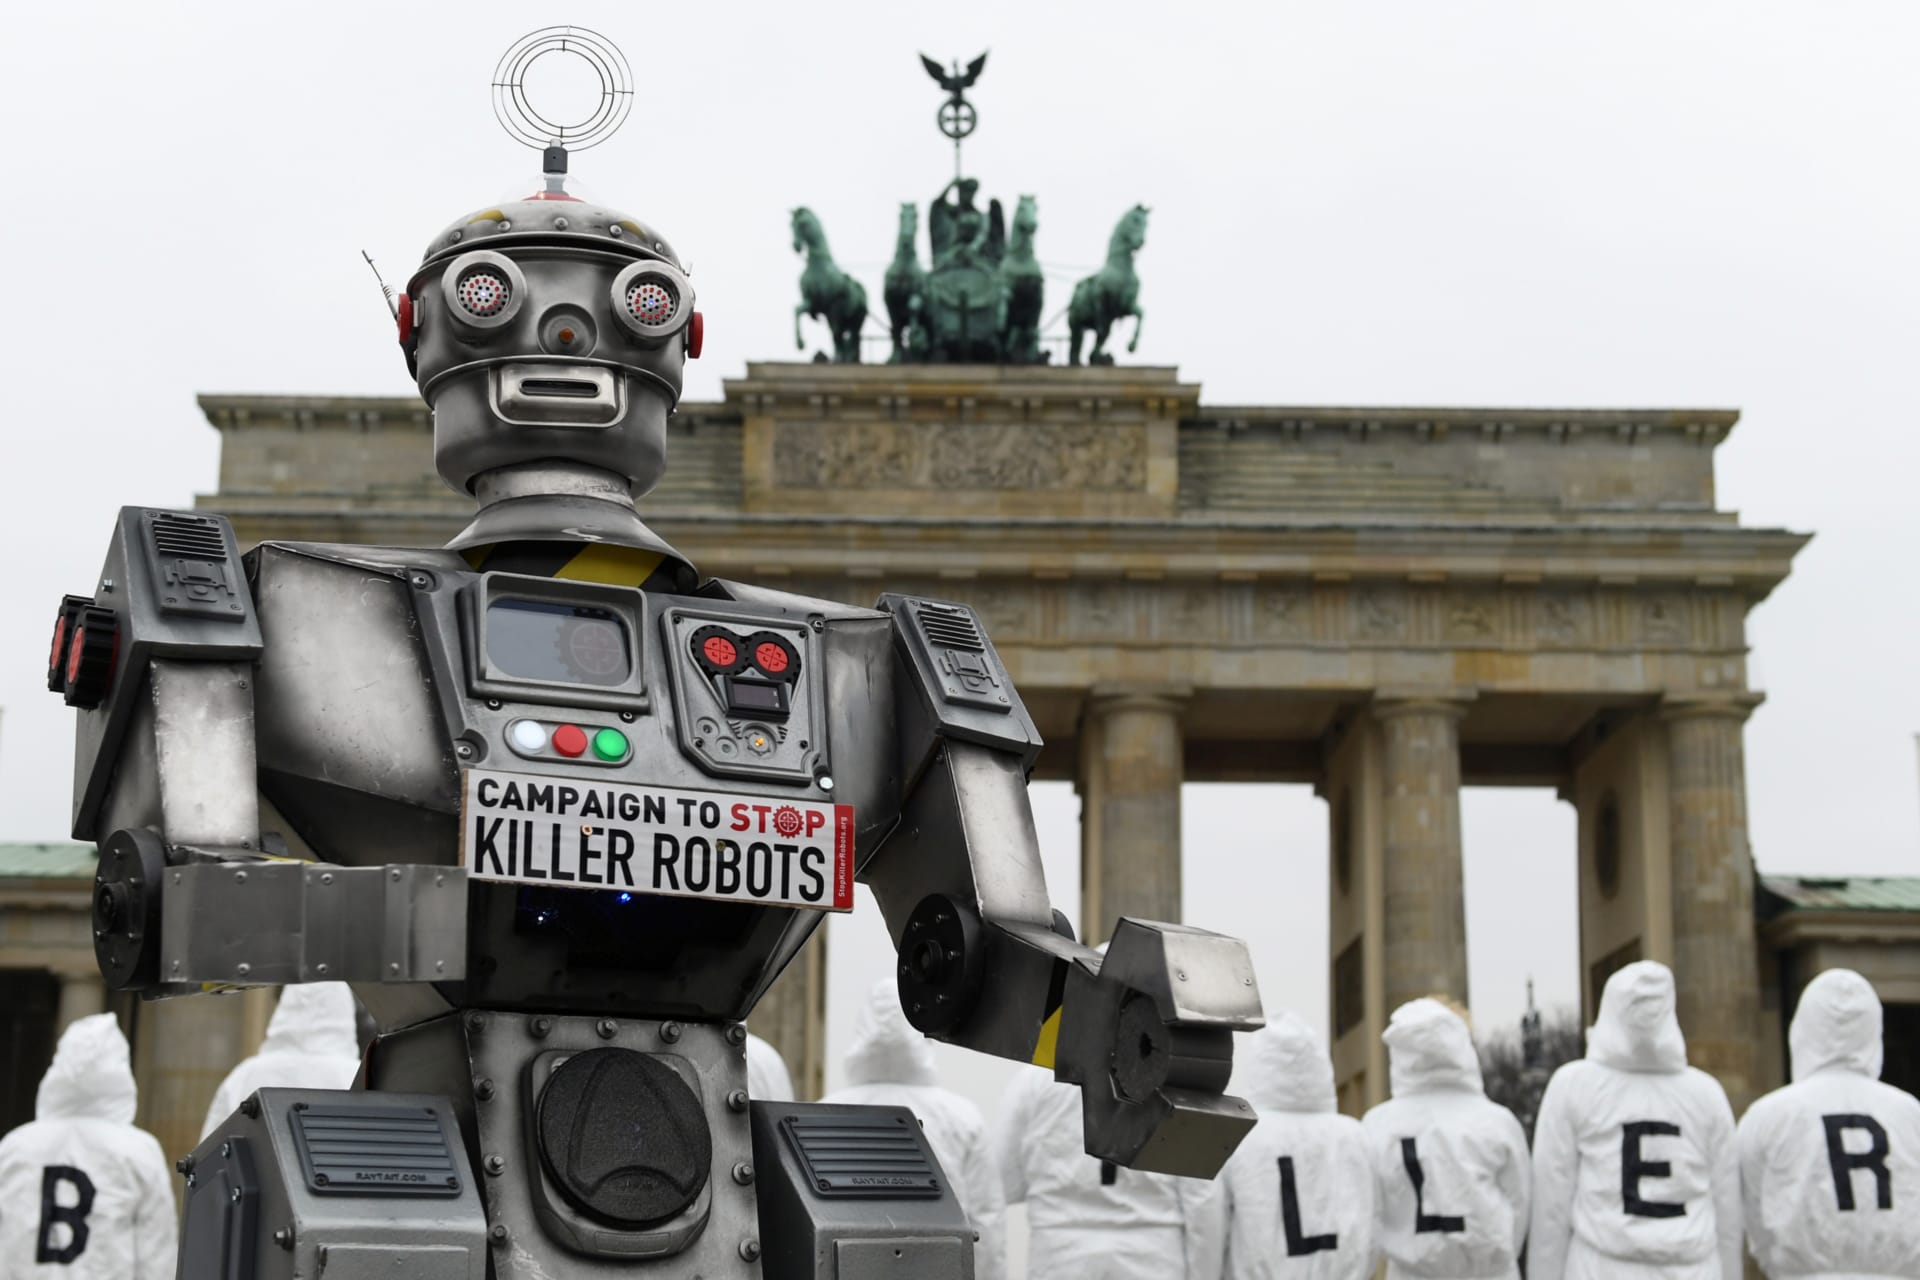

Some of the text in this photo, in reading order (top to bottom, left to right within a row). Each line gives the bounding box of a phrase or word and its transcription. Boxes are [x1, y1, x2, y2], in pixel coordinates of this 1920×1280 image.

[478, 779, 665, 825] CAMPAIGN
[677, 799, 721, 830] TO
[475, 816, 826, 903] KILLER ROBOTS
[838, 816, 849, 897] StopKillerRobots.org
[355, 1171, 427, 1182] RAYTAIT.COM
[1277, 1155, 1339, 1258] L
[1400, 1137, 1466, 1235] L
[1621, 1120, 1687, 1220] E
[1822, 1113, 1893, 1212] R
[36, 1165, 97, 1265] B
